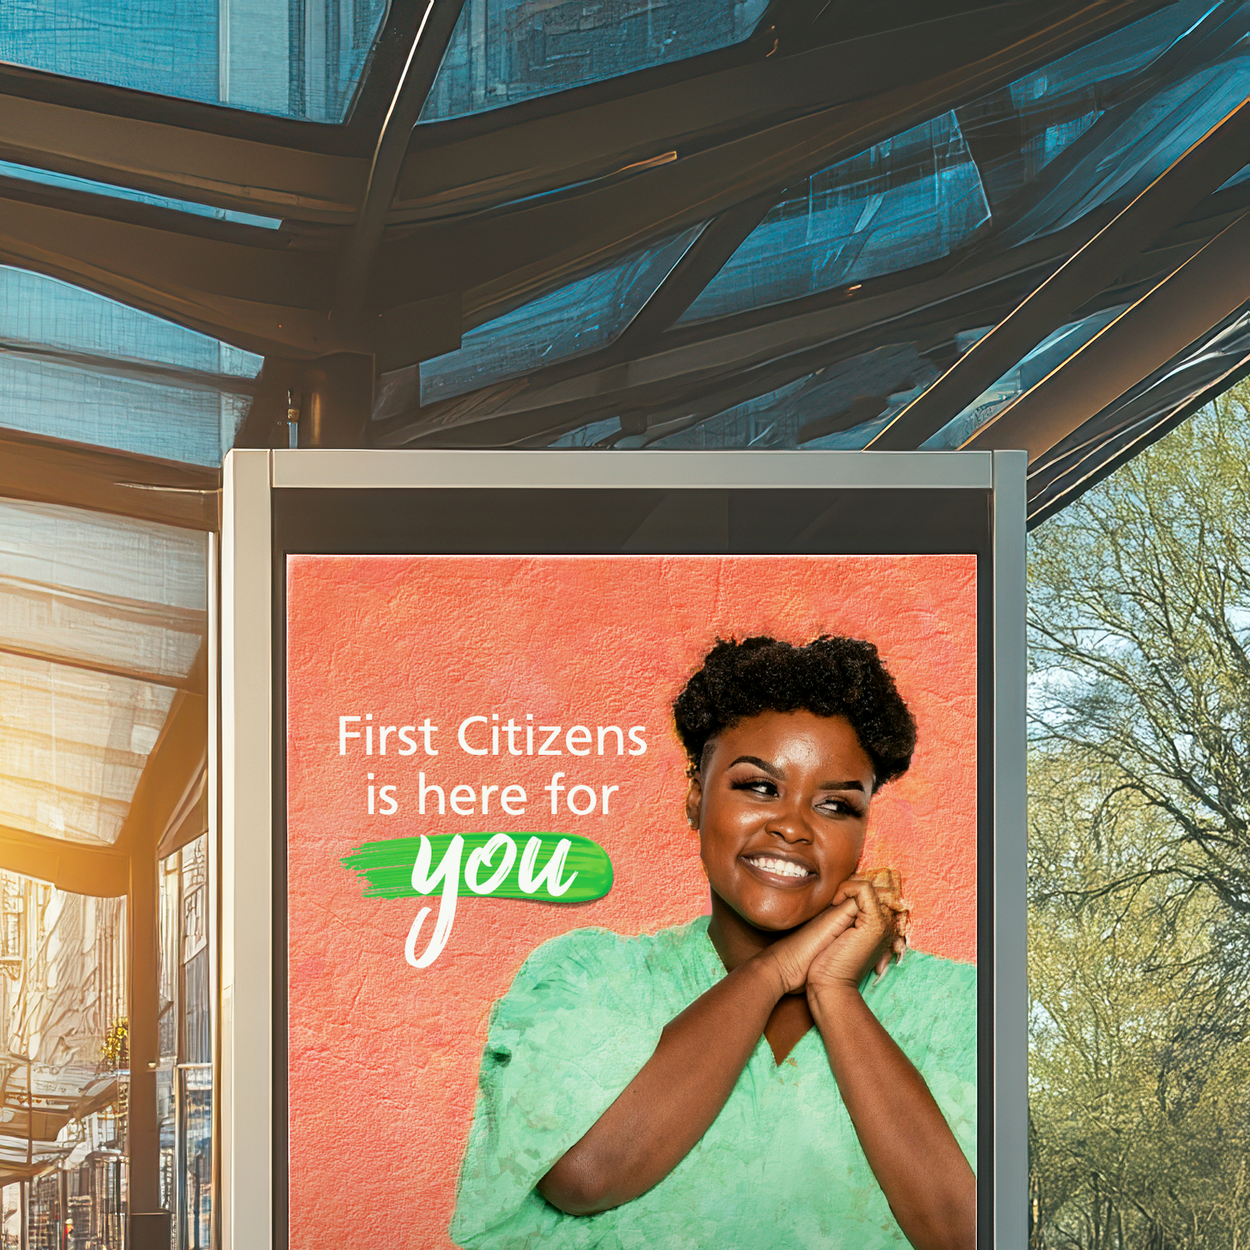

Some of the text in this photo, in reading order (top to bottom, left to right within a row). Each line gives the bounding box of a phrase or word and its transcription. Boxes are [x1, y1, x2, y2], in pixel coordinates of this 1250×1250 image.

[339, 713, 648, 756] First Citizens
[367, 771, 619, 816] is here for
[404, 833, 579, 969] you
